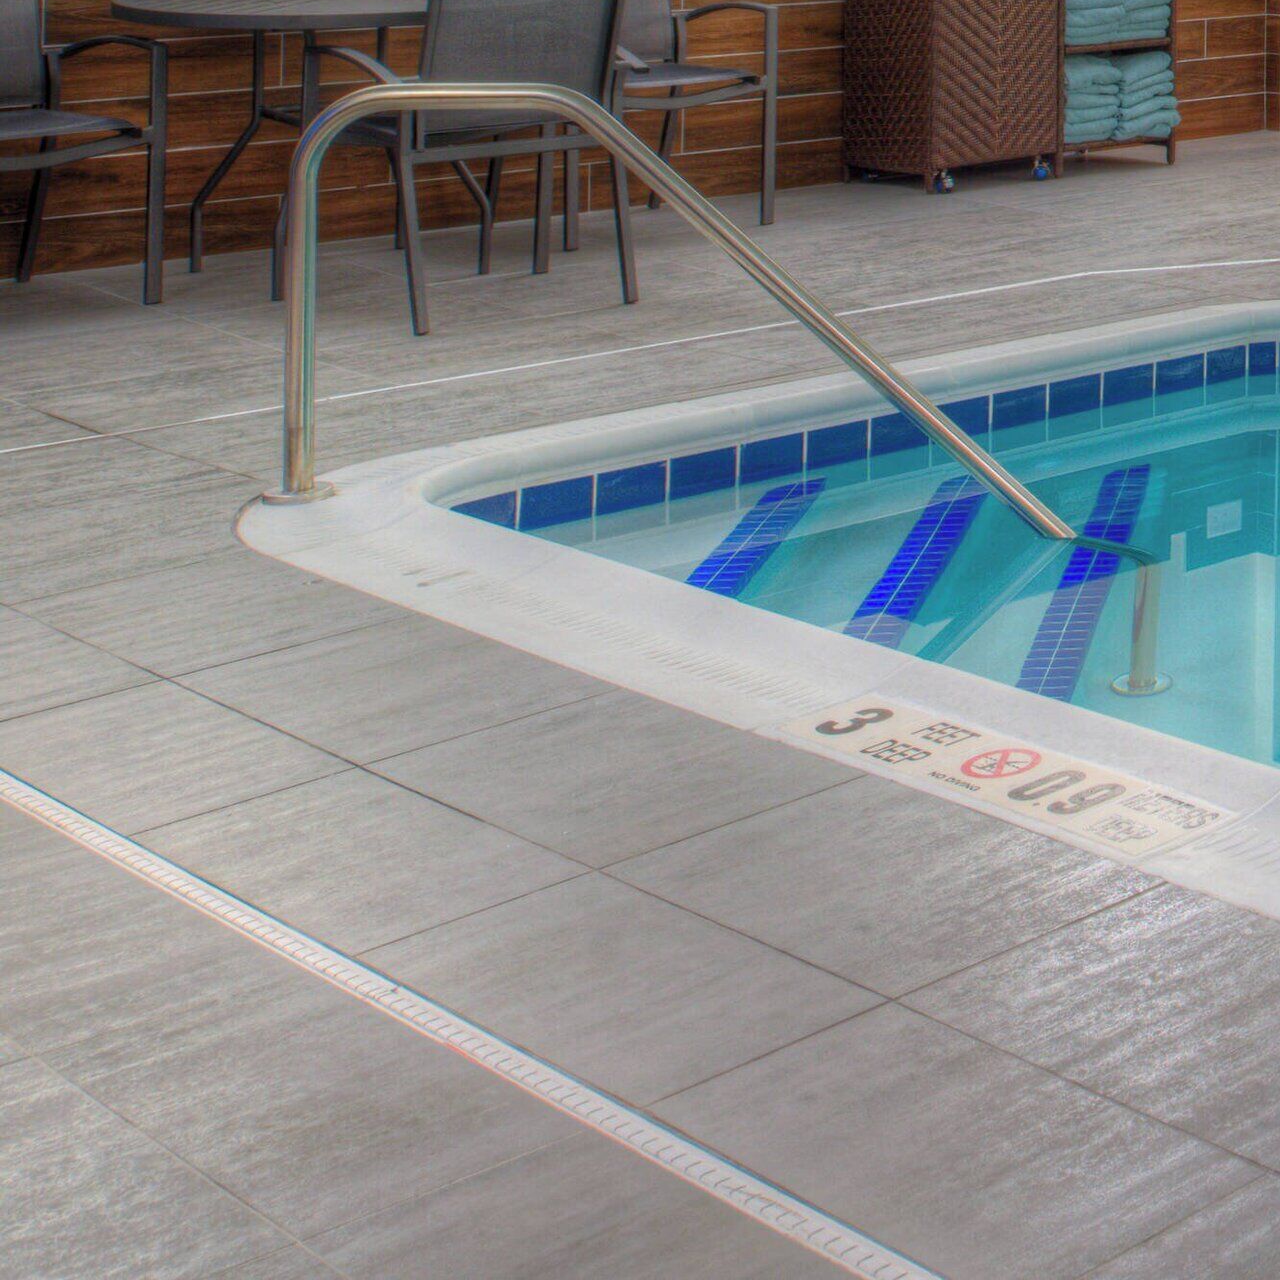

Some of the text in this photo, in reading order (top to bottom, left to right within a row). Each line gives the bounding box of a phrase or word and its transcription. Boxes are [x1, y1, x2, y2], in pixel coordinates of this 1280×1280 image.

[815, 708, 981, 747] 3 FEET
[860, 738, 933, 764] DEEP
[928, 770, 947, 780] NO
